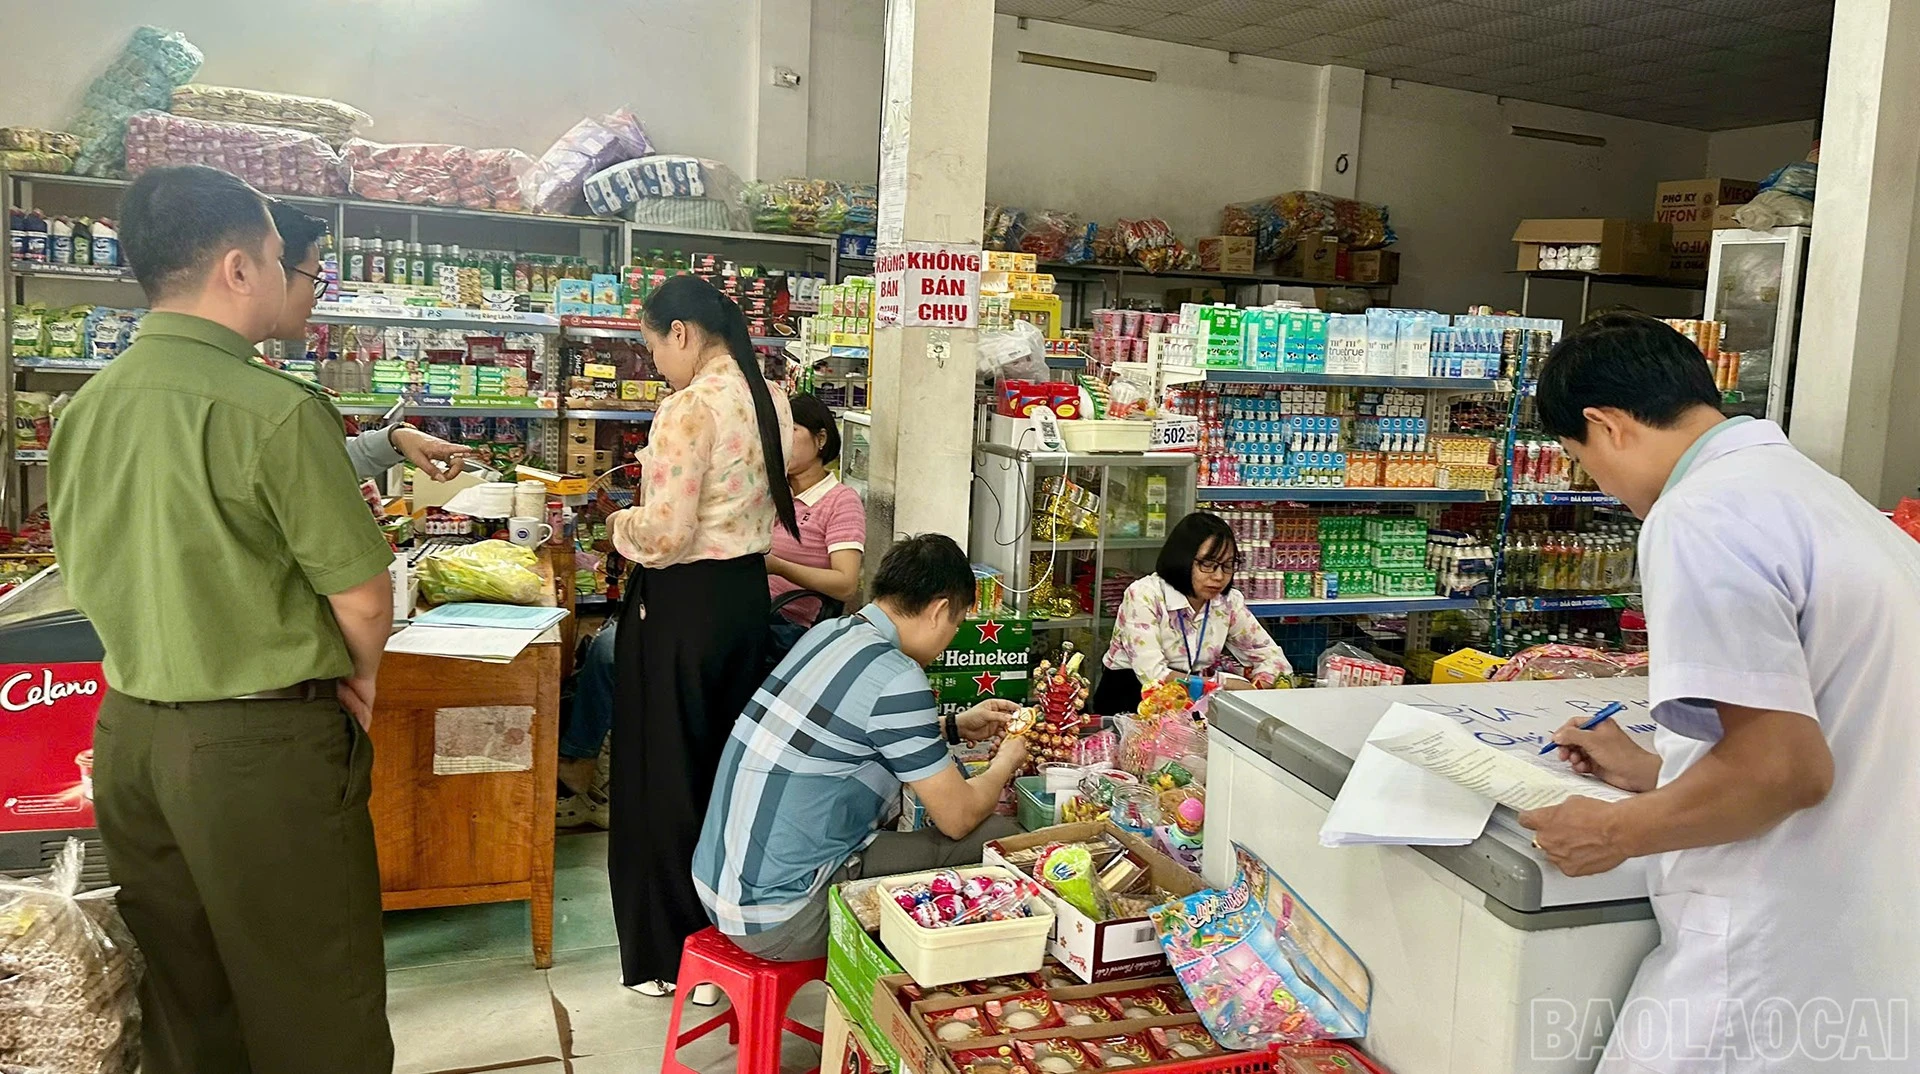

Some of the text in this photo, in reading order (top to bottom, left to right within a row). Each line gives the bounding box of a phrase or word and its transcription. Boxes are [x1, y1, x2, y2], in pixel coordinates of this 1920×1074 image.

[1656, 209, 1698, 223] VIFON
[876, 251, 905, 273] KHÔNG
[907, 250, 980, 272] KHÔNG
[880, 277, 898, 298] BÁN
[921, 275, 966, 296] BÁN
[918, 303, 968, 324] CHỊU
[1344, 348, 1364, 356] true
[1164, 427, 1185, 444] 502
[945, 649, 1028, 667] Heineken
[0, 668, 98, 713] Celano
